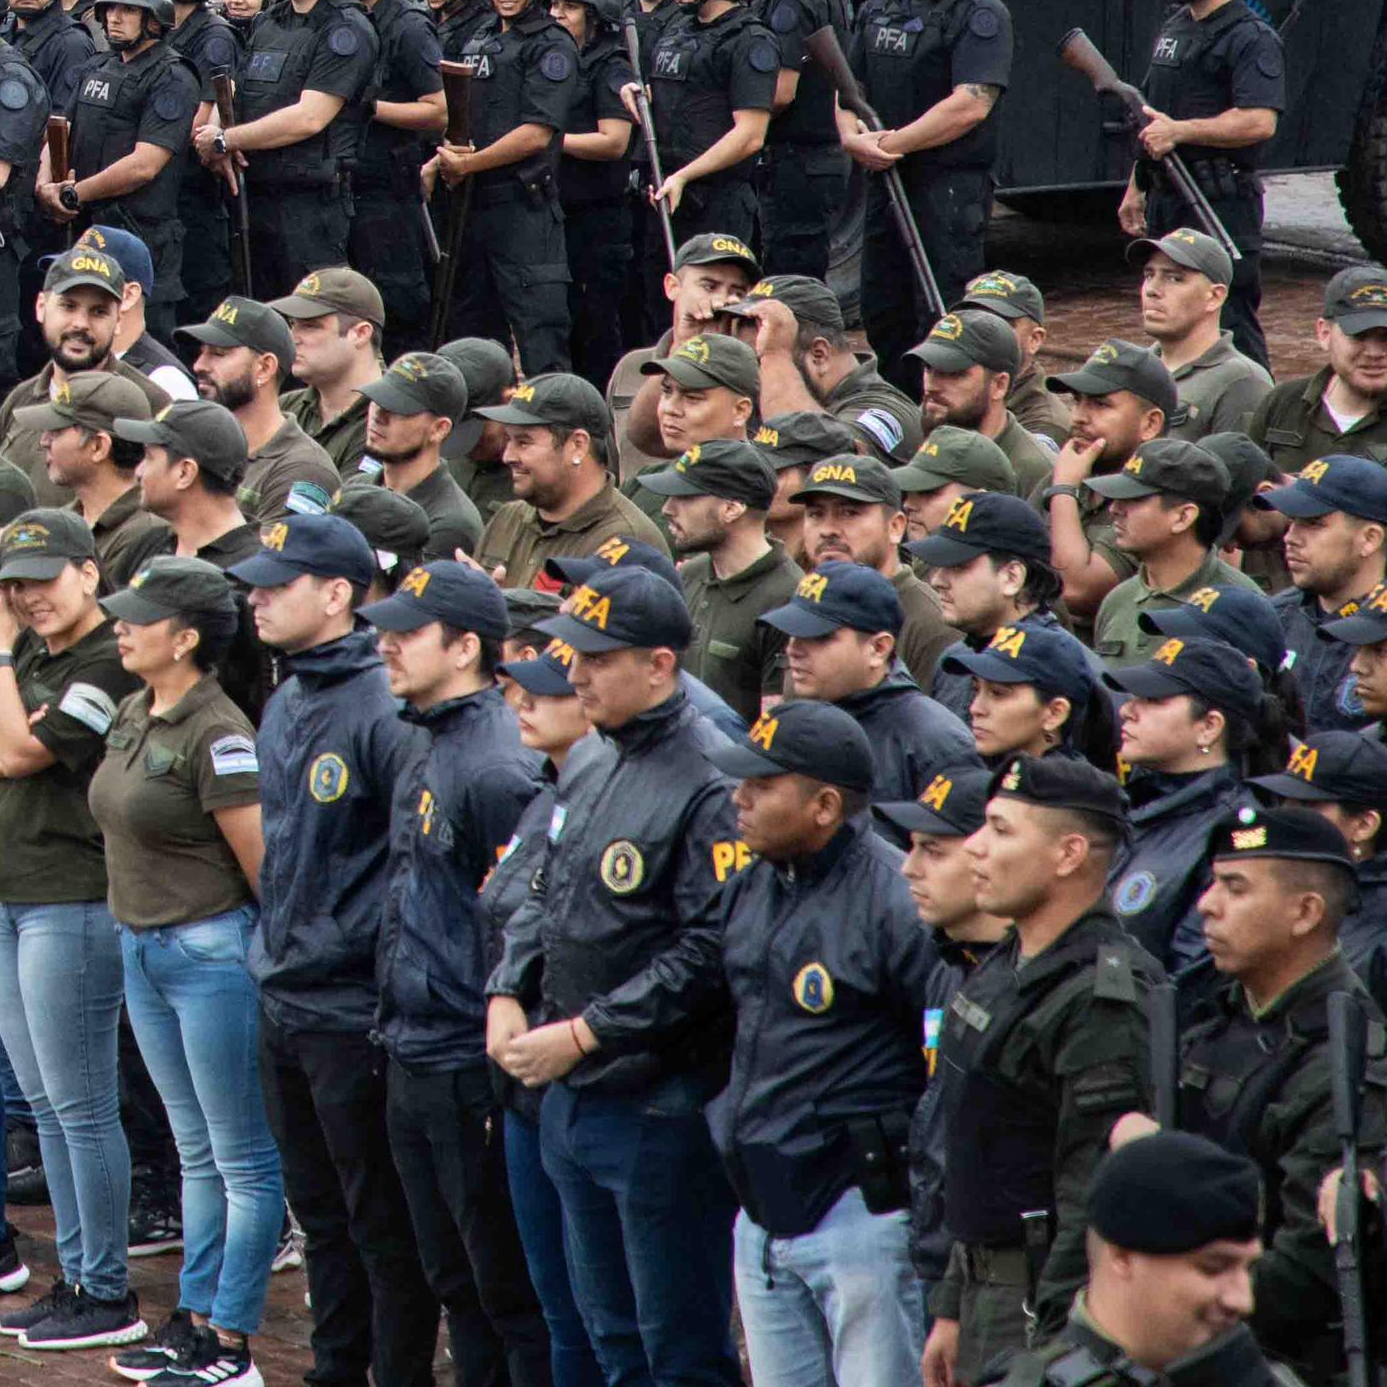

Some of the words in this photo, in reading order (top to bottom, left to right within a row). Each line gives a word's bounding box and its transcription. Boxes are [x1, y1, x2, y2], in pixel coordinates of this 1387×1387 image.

[875, 27, 908, 52] PFA
[1153, 37, 1179, 59] PFA
[656, 51, 682, 74] PFA
[83, 79, 112, 101] PFA
[71, 256, 111, 278] GNA
[812, 464, 858, 484] GNA
[944, 497, 975, 532] FA
[987, 625, 1026, 659] FA
